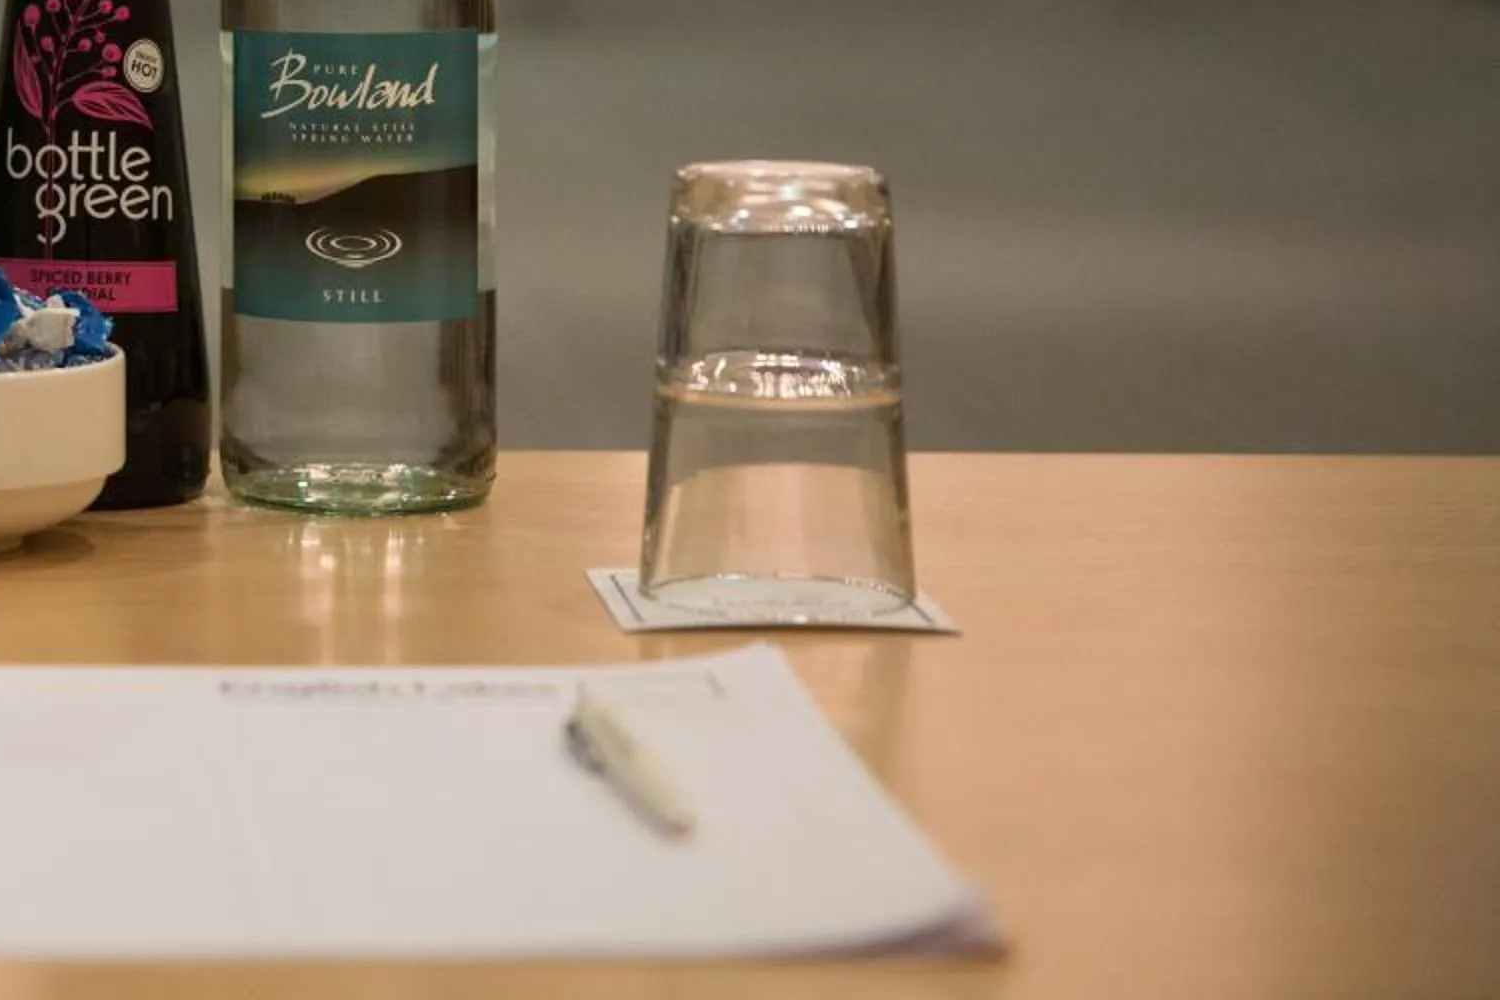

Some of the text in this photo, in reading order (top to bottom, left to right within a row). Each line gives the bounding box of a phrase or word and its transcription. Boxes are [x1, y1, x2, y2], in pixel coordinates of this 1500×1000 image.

[131, 60, 157, 80] HOT
[313, 64, 359, 75] PURE
[260, 48, 439, 118] Bowland
[6, 126, 152, 182] bottle
[35, 183, 173, 245] green
[29, 269, 132, 286] SPICED BERRY
[322, 289, 384, 303] STILL
